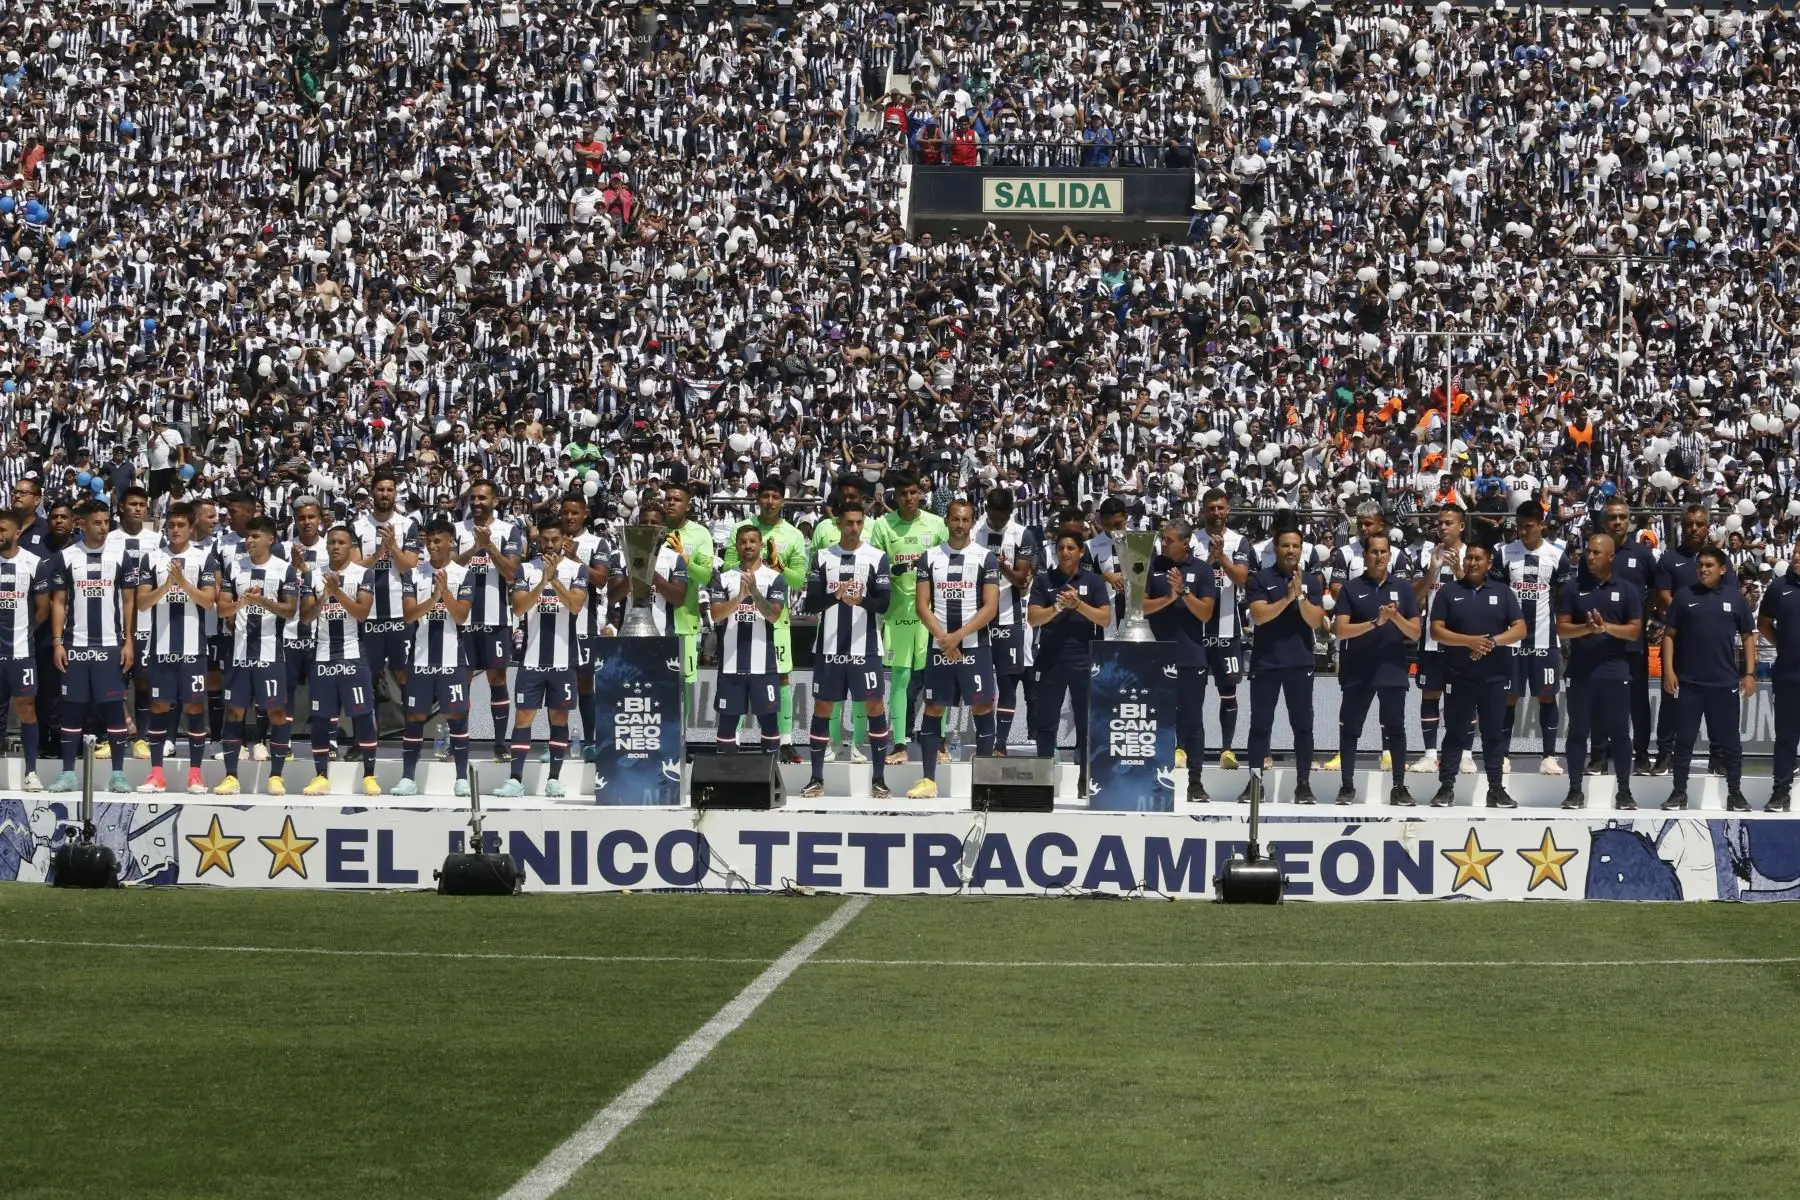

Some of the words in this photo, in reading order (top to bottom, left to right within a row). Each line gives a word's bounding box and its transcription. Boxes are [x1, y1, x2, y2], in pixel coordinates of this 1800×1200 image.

[994, 181, 1111, 209] SALIDA
[1513, 481, 1529, 491] DG
[76, 579, 112, 588] apuesta
[936, 581, 973, 590] apuesta
[1512, 581, 1548, 591] apuesta
[0, 590, 25, 599] uesta
[83, 588, 105, 597] total
[166, 593, 188, 603] total
[942, 590, 966, 599] total
[1517, 590, 1541, 600] total
[0, 599, 18, 608] otal
[537, 604, 560, 613] total
[325, 610, 347, 620] total
[426, 611, 447, 620] total
[735, 611, 757, 622] total
[495, 640, 503, 658] 6
[1009, 647, 1017, 665] 4
[1223, 656, 1240, 674] 30
[22, 667, 34, 686] 21
[864, 671, 878, 690] 19
[1543, 667, 1555, 685] 18
[191, 674, 205, 692] 29
[265, 679, 278, 697] 17
[973, 674, 982, 692] 9
[352, 686, 365, 704] 11
[448, 683, 464, 703] 34
[564, 683, 572, 701] 5
[766, 684, 776, 702] 8
[624, 697, 651, 712] BI
[1120, 703, 1147, 719] BI
[614, 713, 661, 725] CAM
[1109, 719, 1157, 731] CAM
[614, 725, 661, 738] PEO
[615, 738, 661, 751] NES
[1109, 732, 1157, 745] PEO
[1109, 744, 1156, 758] NES
[325, 828, 419, 884] EL
